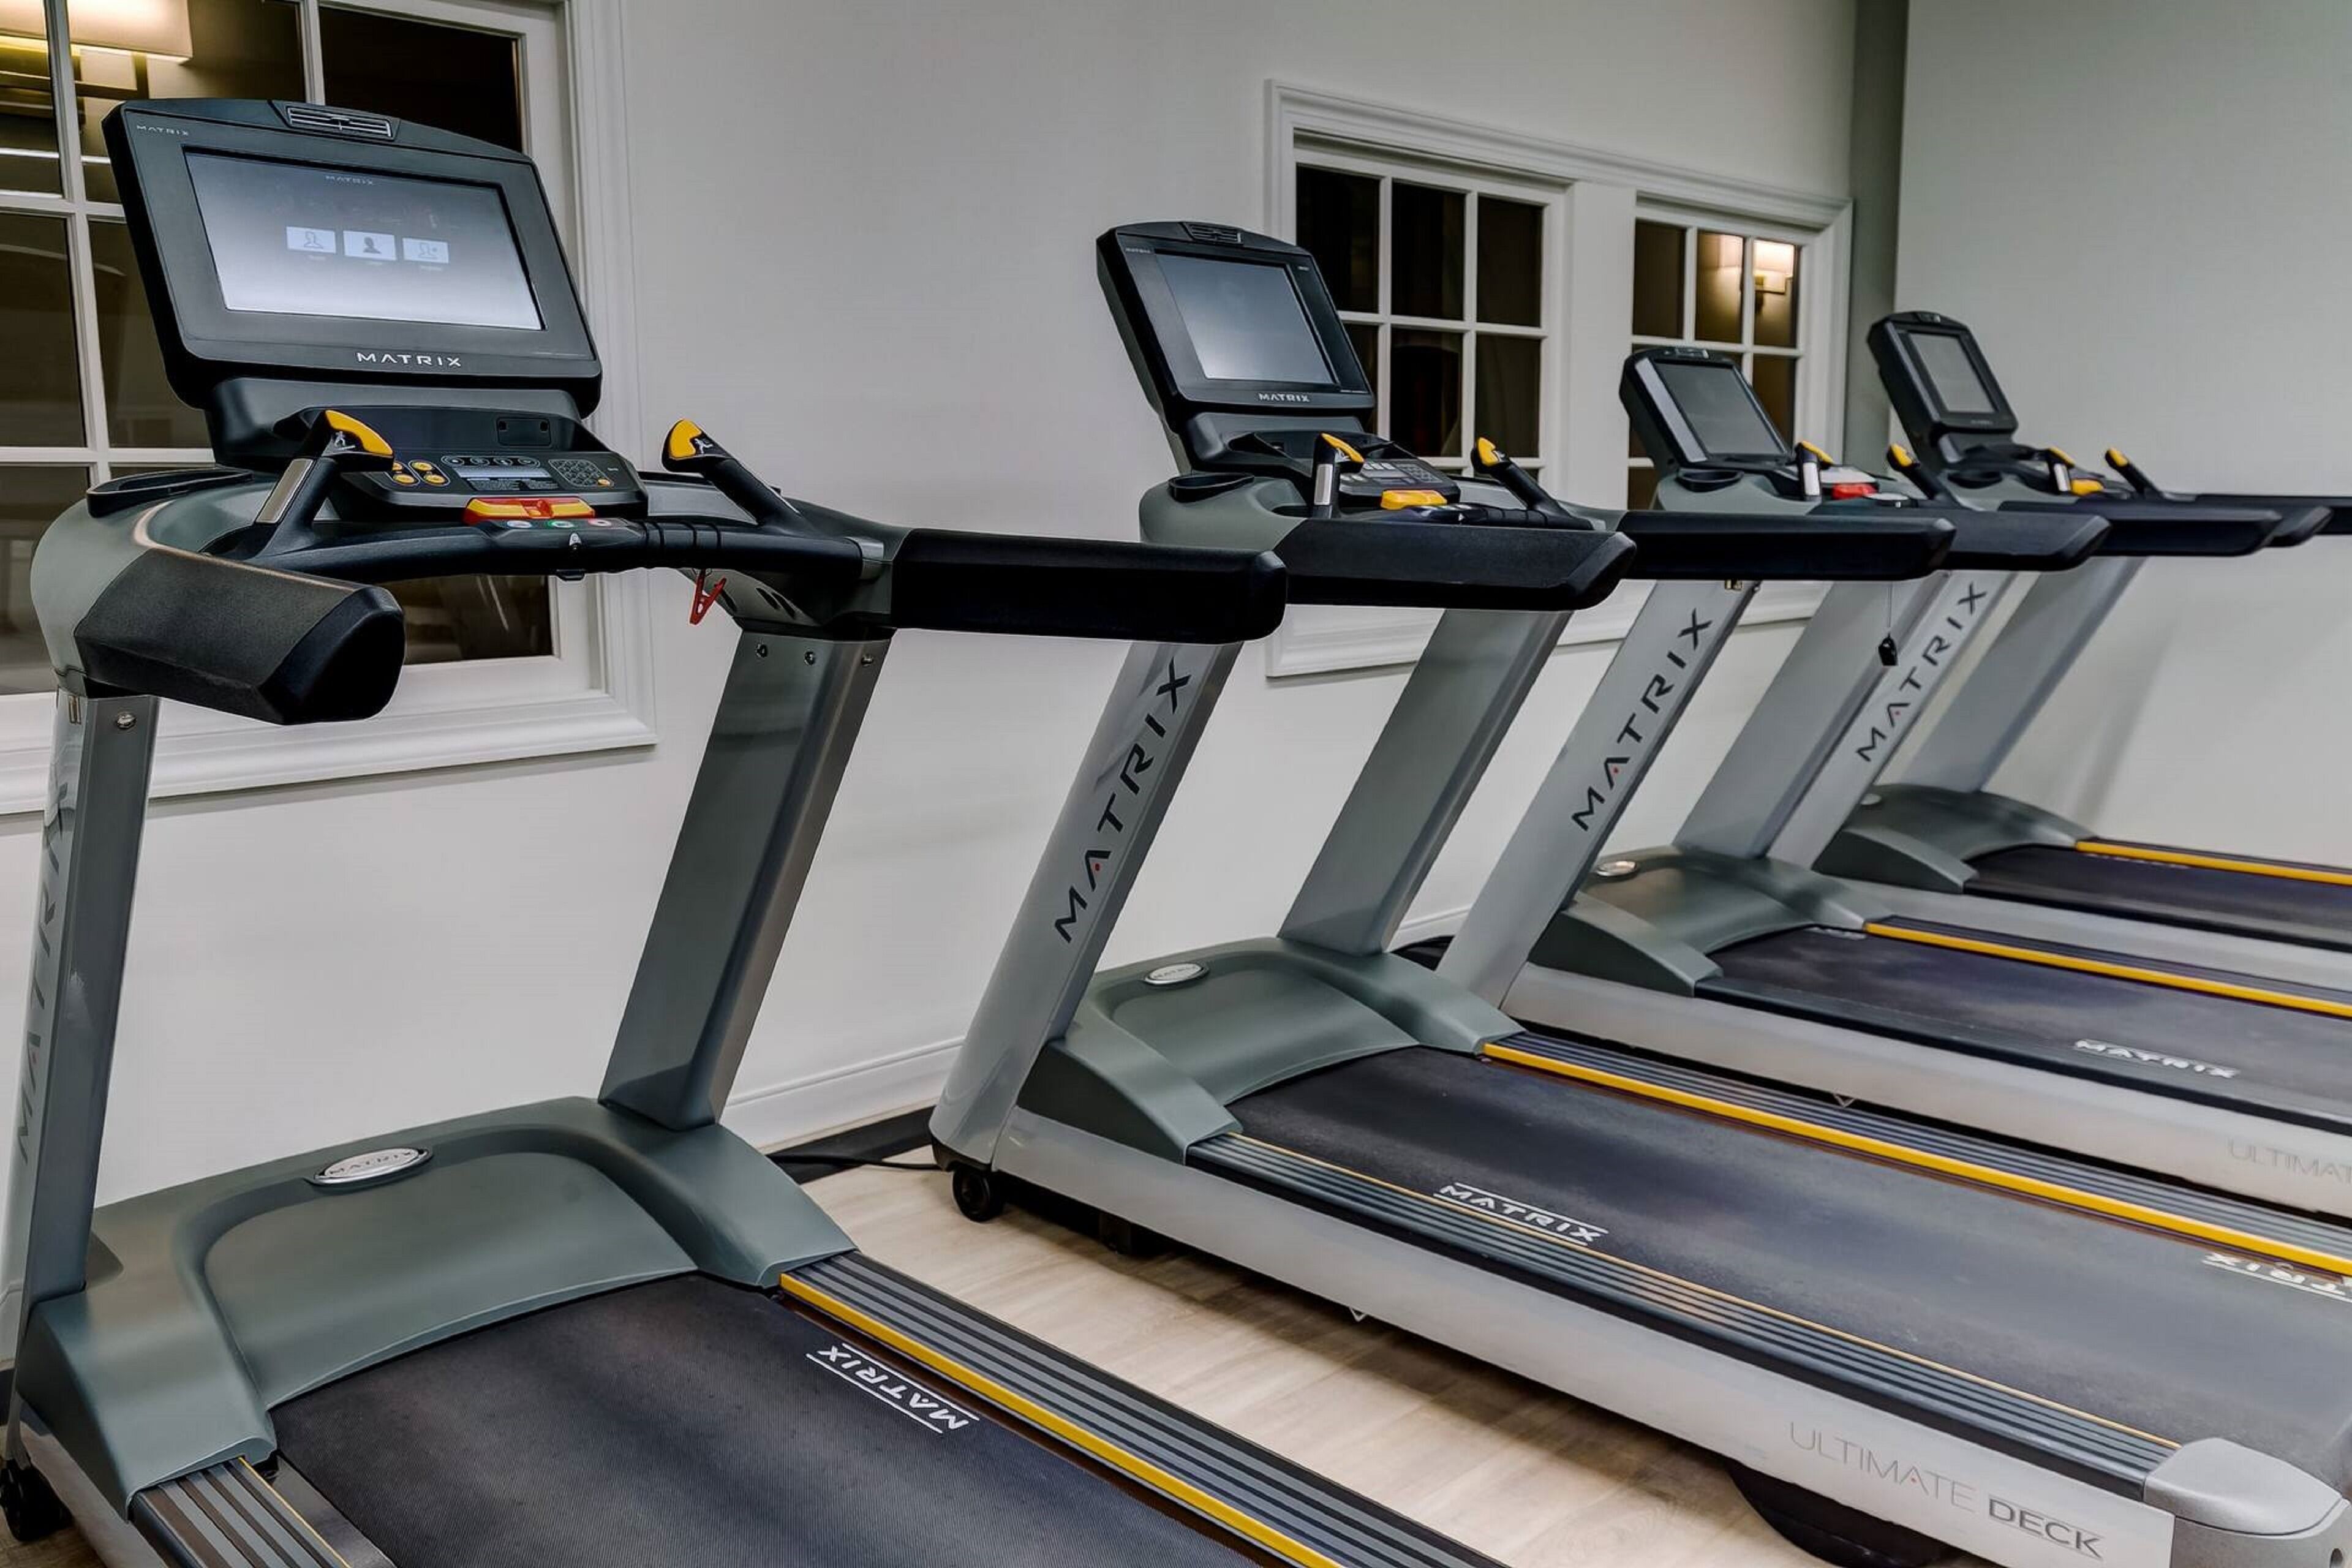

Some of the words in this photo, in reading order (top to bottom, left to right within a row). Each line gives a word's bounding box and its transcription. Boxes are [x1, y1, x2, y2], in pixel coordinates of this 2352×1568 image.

[356, 352, 461, 367] MATRIX
[1258, 393, 1310, 402] MATRIX
[1571, 608, 1713, 831] MATRIX
[1856, 582, 1987, 762] MATRIX
[1054, 657, 1192, 943] MATRIX
[1439, 1185, 1601, 1242] MATRIX
[817, 1345, 970, 1430] MATRIX
[1789, 1421, 1978, 1513] ULTIMATE
[1988, 1496, 2104, 1561] DECK
